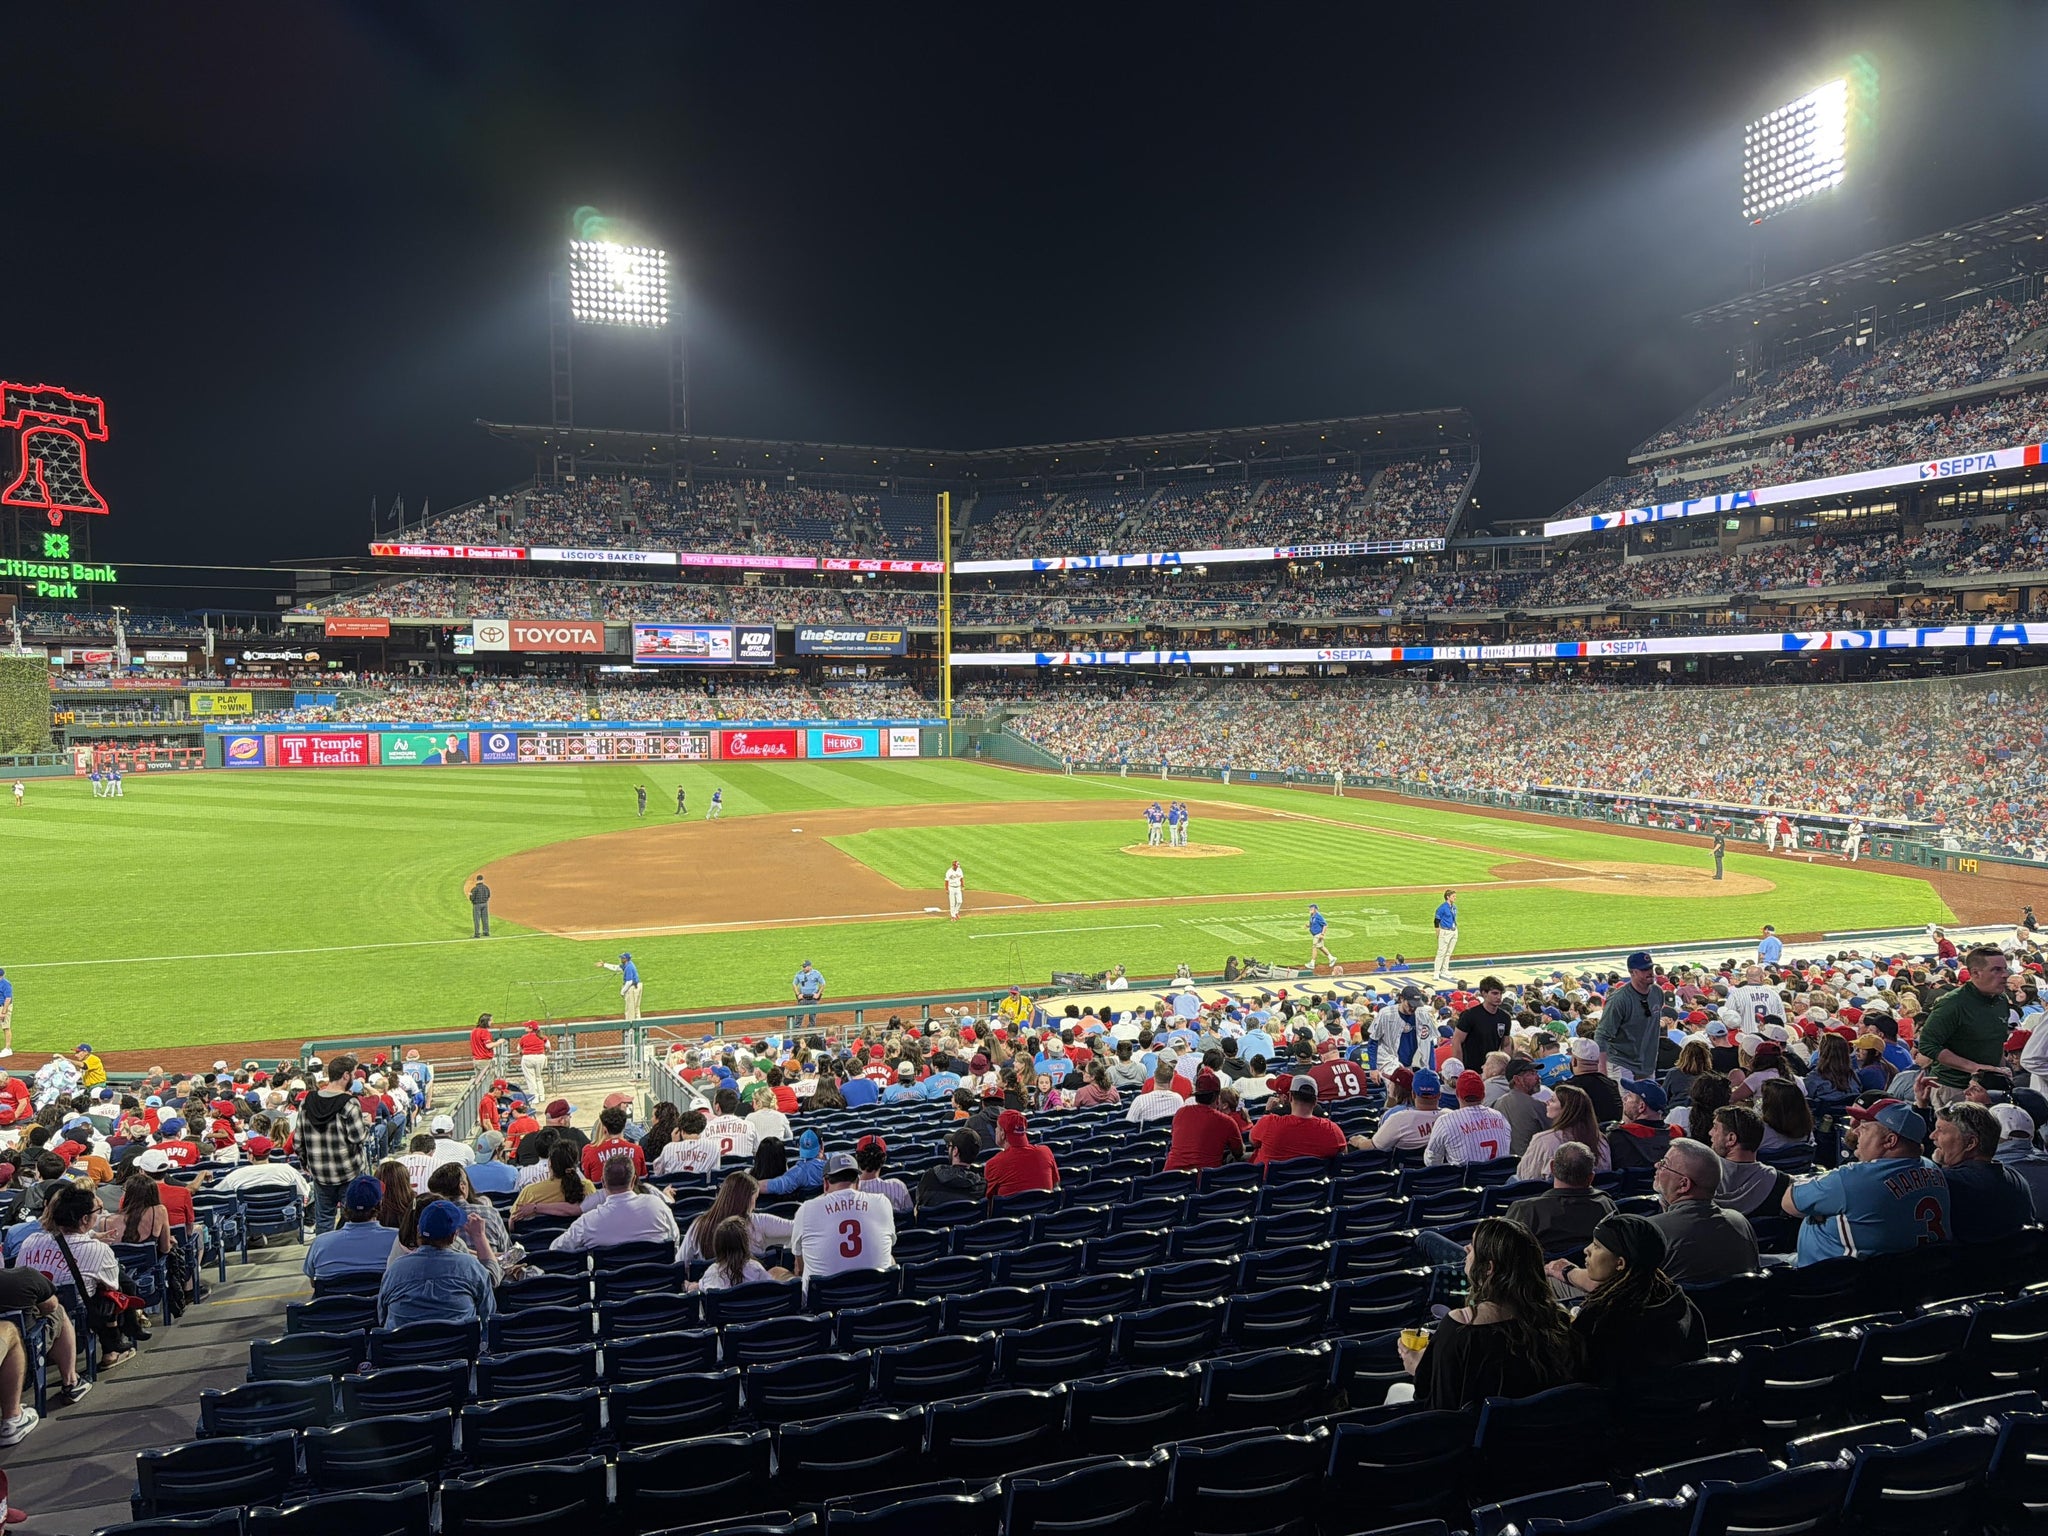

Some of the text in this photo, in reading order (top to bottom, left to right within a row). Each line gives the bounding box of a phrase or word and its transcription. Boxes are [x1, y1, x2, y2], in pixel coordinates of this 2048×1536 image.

[1940, 454, 1996, 476] SEPTA
[400, 547, 449, 556] Phillies win
[562, 551, 647, 562] LISCIO'S BAKERY
[0, 559, 116, 582] Citizens Bank
[38, 580, 78, 598] Park
[514, 628, 596, 644] TOYOTA
[800, 630, 866, 641] theScore
[1332, 650, 1372, 660] SEPTA
[1612, 642, 1648, 654] SEPTA
[54, 712, 75, 724] 1:49
[311, 738, 362, 750] Temple
[731, 737, 787, 755] Chick-fil-A
[827, 738, 858, 749] HERR'S
[313, 751, 360, 763] Health
[1177, 910, 1358, 924] Independece
[1750, 993, 1769, 1002] HAPP
[794, 1084, 816, 1093] ANCHEZ
[1334, 1074, 1360, 1096] 19
[705, 1122, 748, 1138] CRAWFORD
[1460, 1118, 1504, 1134] MAMENKO
[170, 1148, 188, 1158] RPER
[721, 1138, 733, 1155] 2
[1480, 1140, 1498, 1160] 7
[676, 1150, 707, 1162] TURNER
[408, 1166, 426, 1176] OTT
[1884, 1167, 1946, 1200] HARPER
[825, 1200, 868, 1215] HARPER
[1914, 1196, 1946, 1248] 3
[838, 1219, 862, 1258] 3
